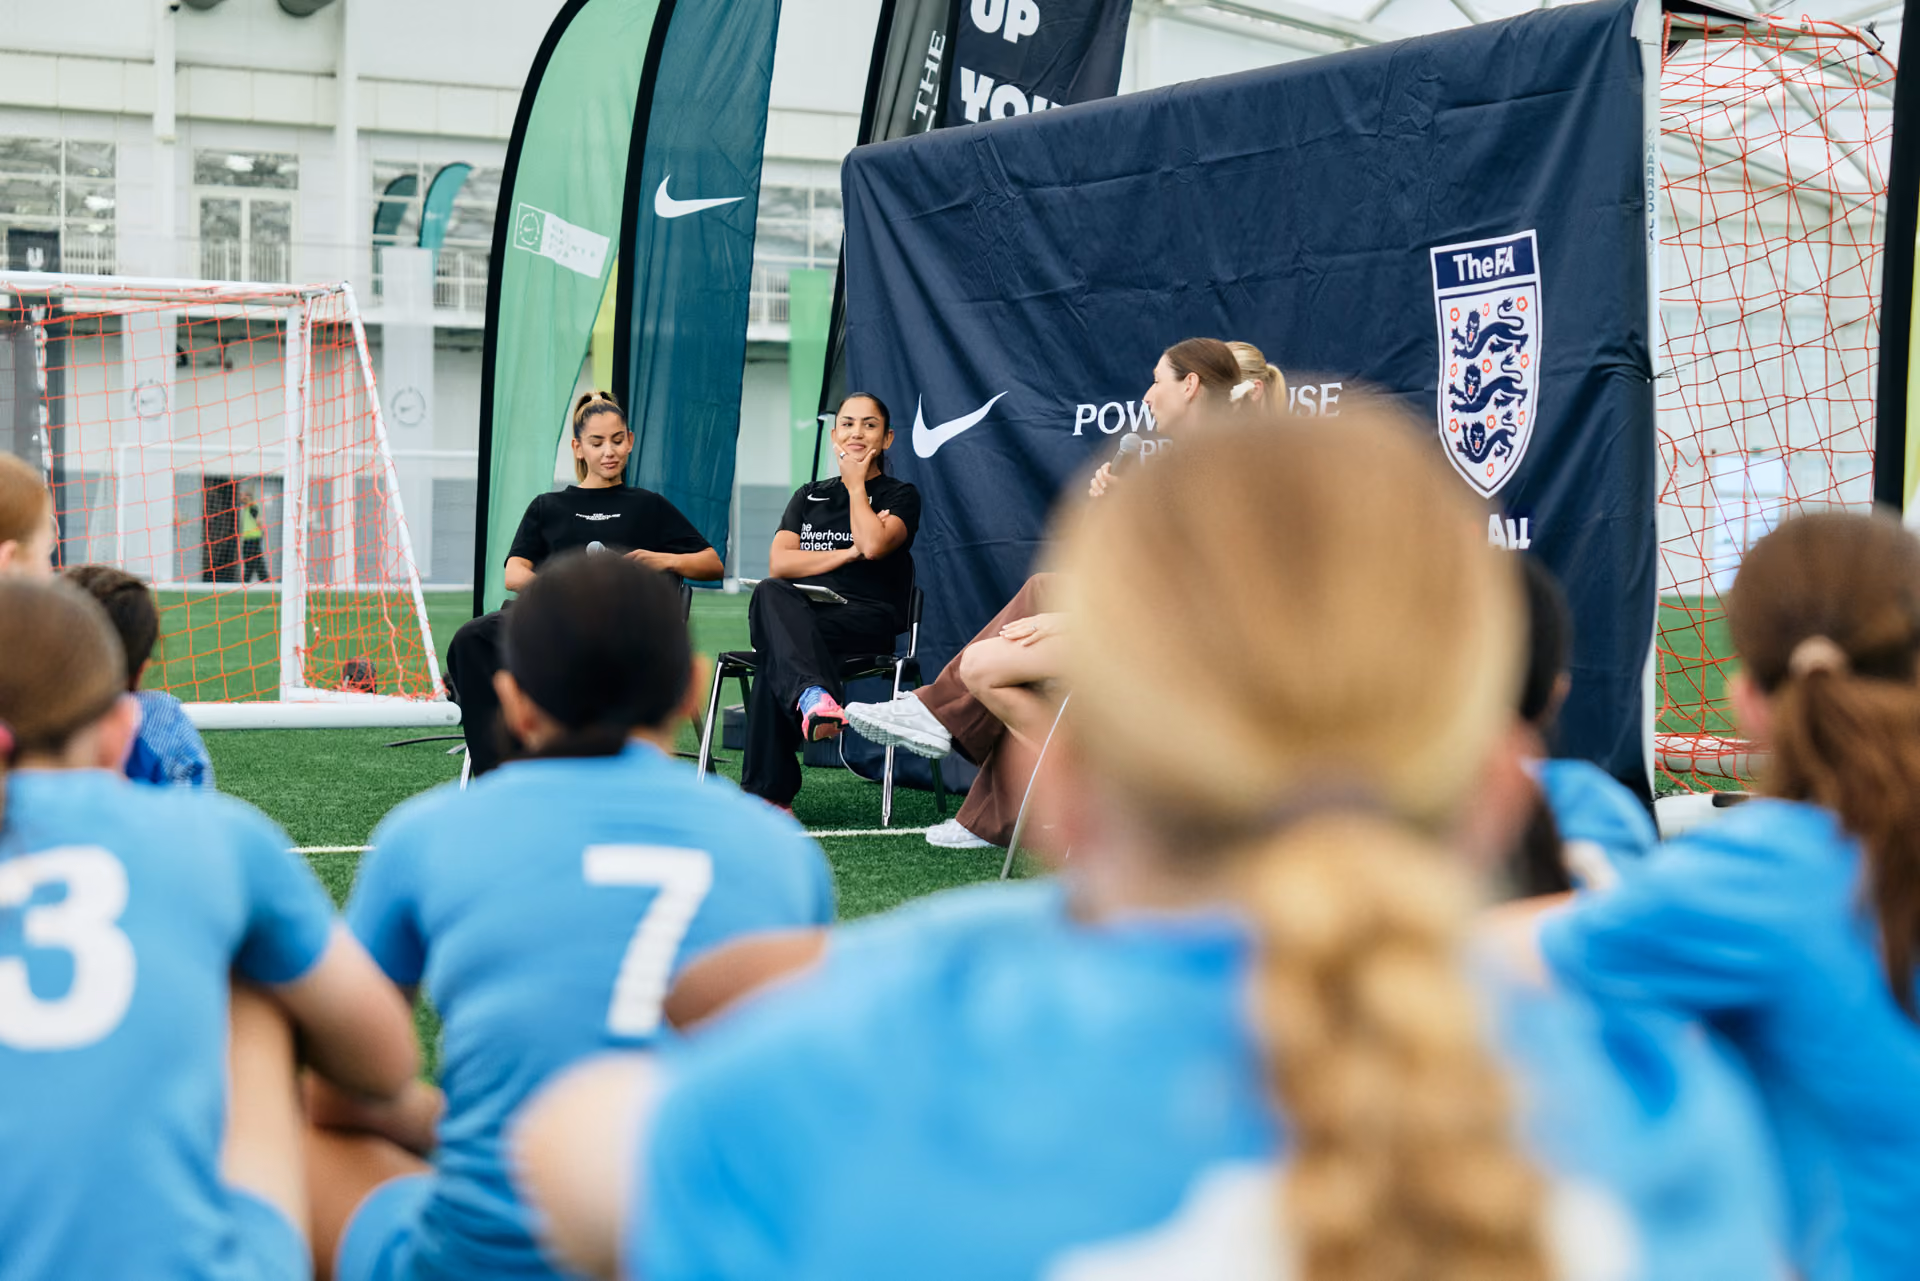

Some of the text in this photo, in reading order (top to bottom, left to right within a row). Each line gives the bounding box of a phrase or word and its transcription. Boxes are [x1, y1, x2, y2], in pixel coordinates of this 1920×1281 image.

[970, 0, 1040, 44] UP
[912, 30, 946, 120] THE
[960, 66, 1064, 123] YO
[800, 530, 854, 541] owerhous
[800, 541, 836, 551] roject.
[1488, 513, 1531, 550] ALL
[0, 844, 138, 1053] 3
[582, 843, 714, 1037] 7
